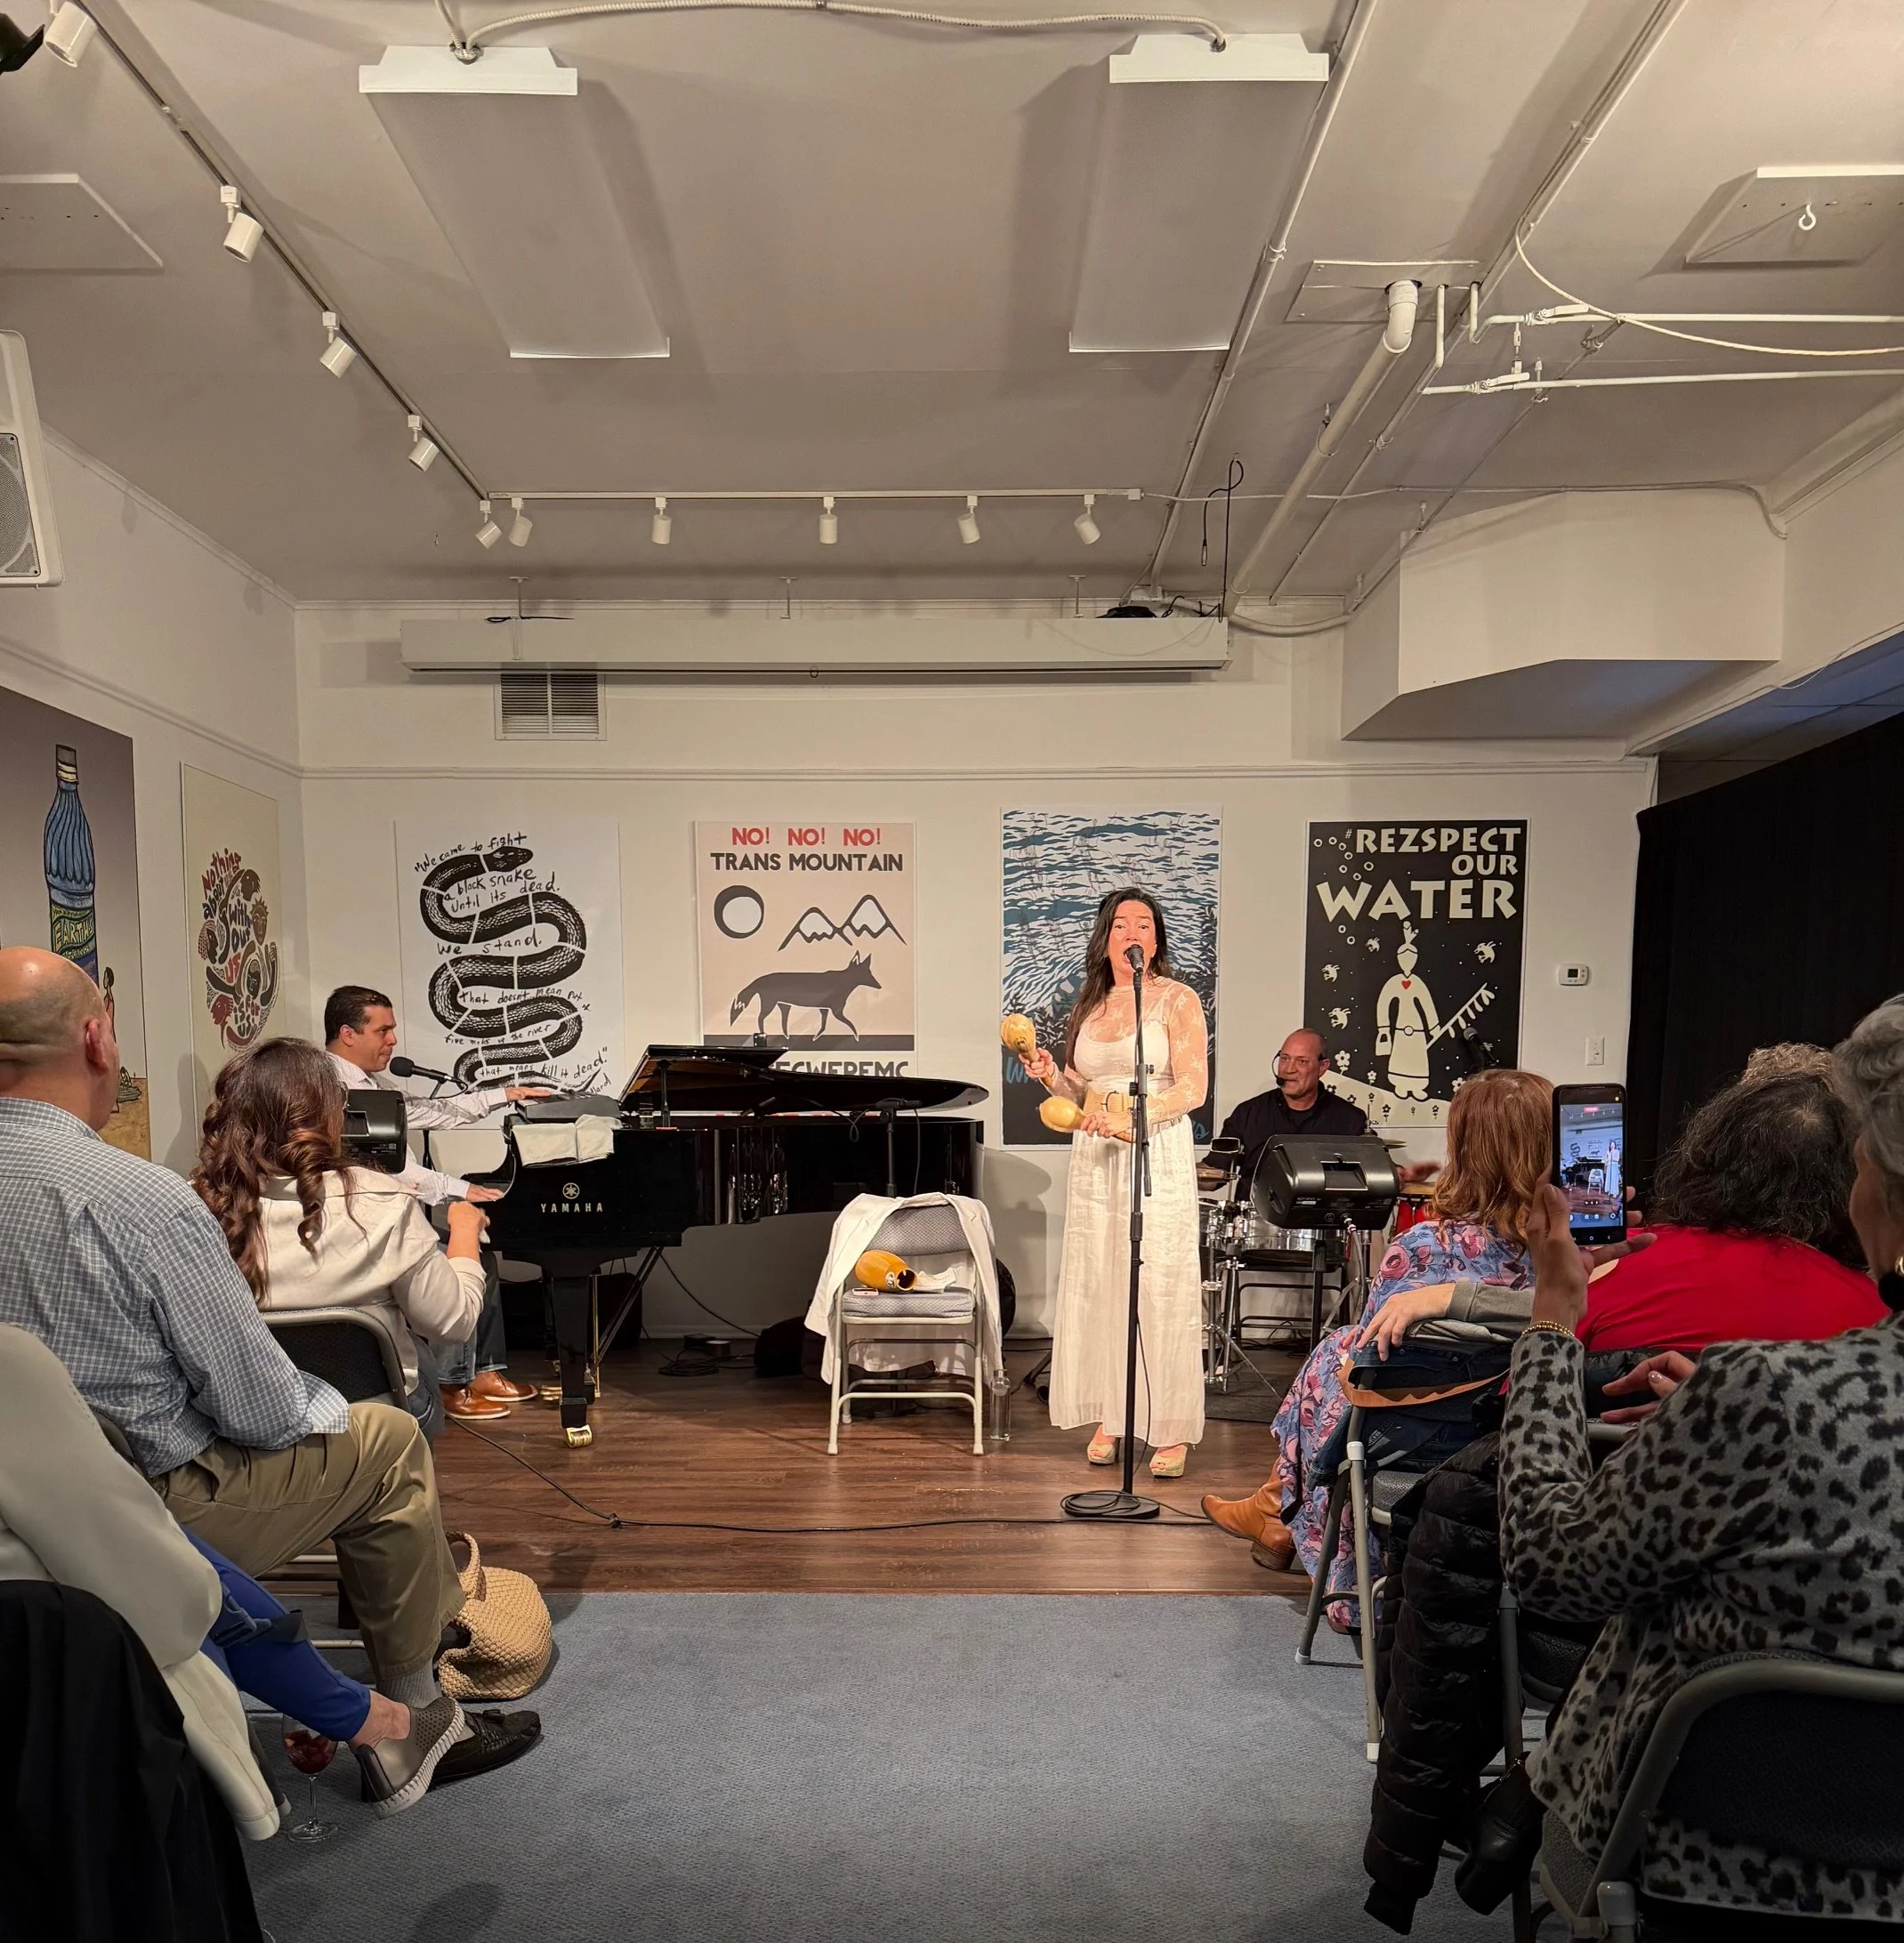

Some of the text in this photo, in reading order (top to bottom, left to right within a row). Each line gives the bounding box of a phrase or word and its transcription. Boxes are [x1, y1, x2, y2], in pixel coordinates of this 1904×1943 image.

[440, 843, 465, 861] came
[471, 841, 483, 853] to
[488, 831, 528, 851] fight
[731, 826, 881, 847] NO! NO! NO!
[1344, 826, 1521, 854] #REZSPECT
[710, 852, 903, 872] TRANS MOUNTAIN
[1451, 854, 1519, 875] OUR
[457, 876, 487, 895] black
[489, 867, 537, 888] snake
[520, 871, 561, 894] dead.
[1316, 879, 1518, 923] WATER
[482, 927, 542, 954] stand.
[528, 1024, 552, 1036] river
[480, 1067, 502, 1077] that
[540, 1063, 558, 1077] kill
[541, 1202, 603, 1213] YAMAHA
